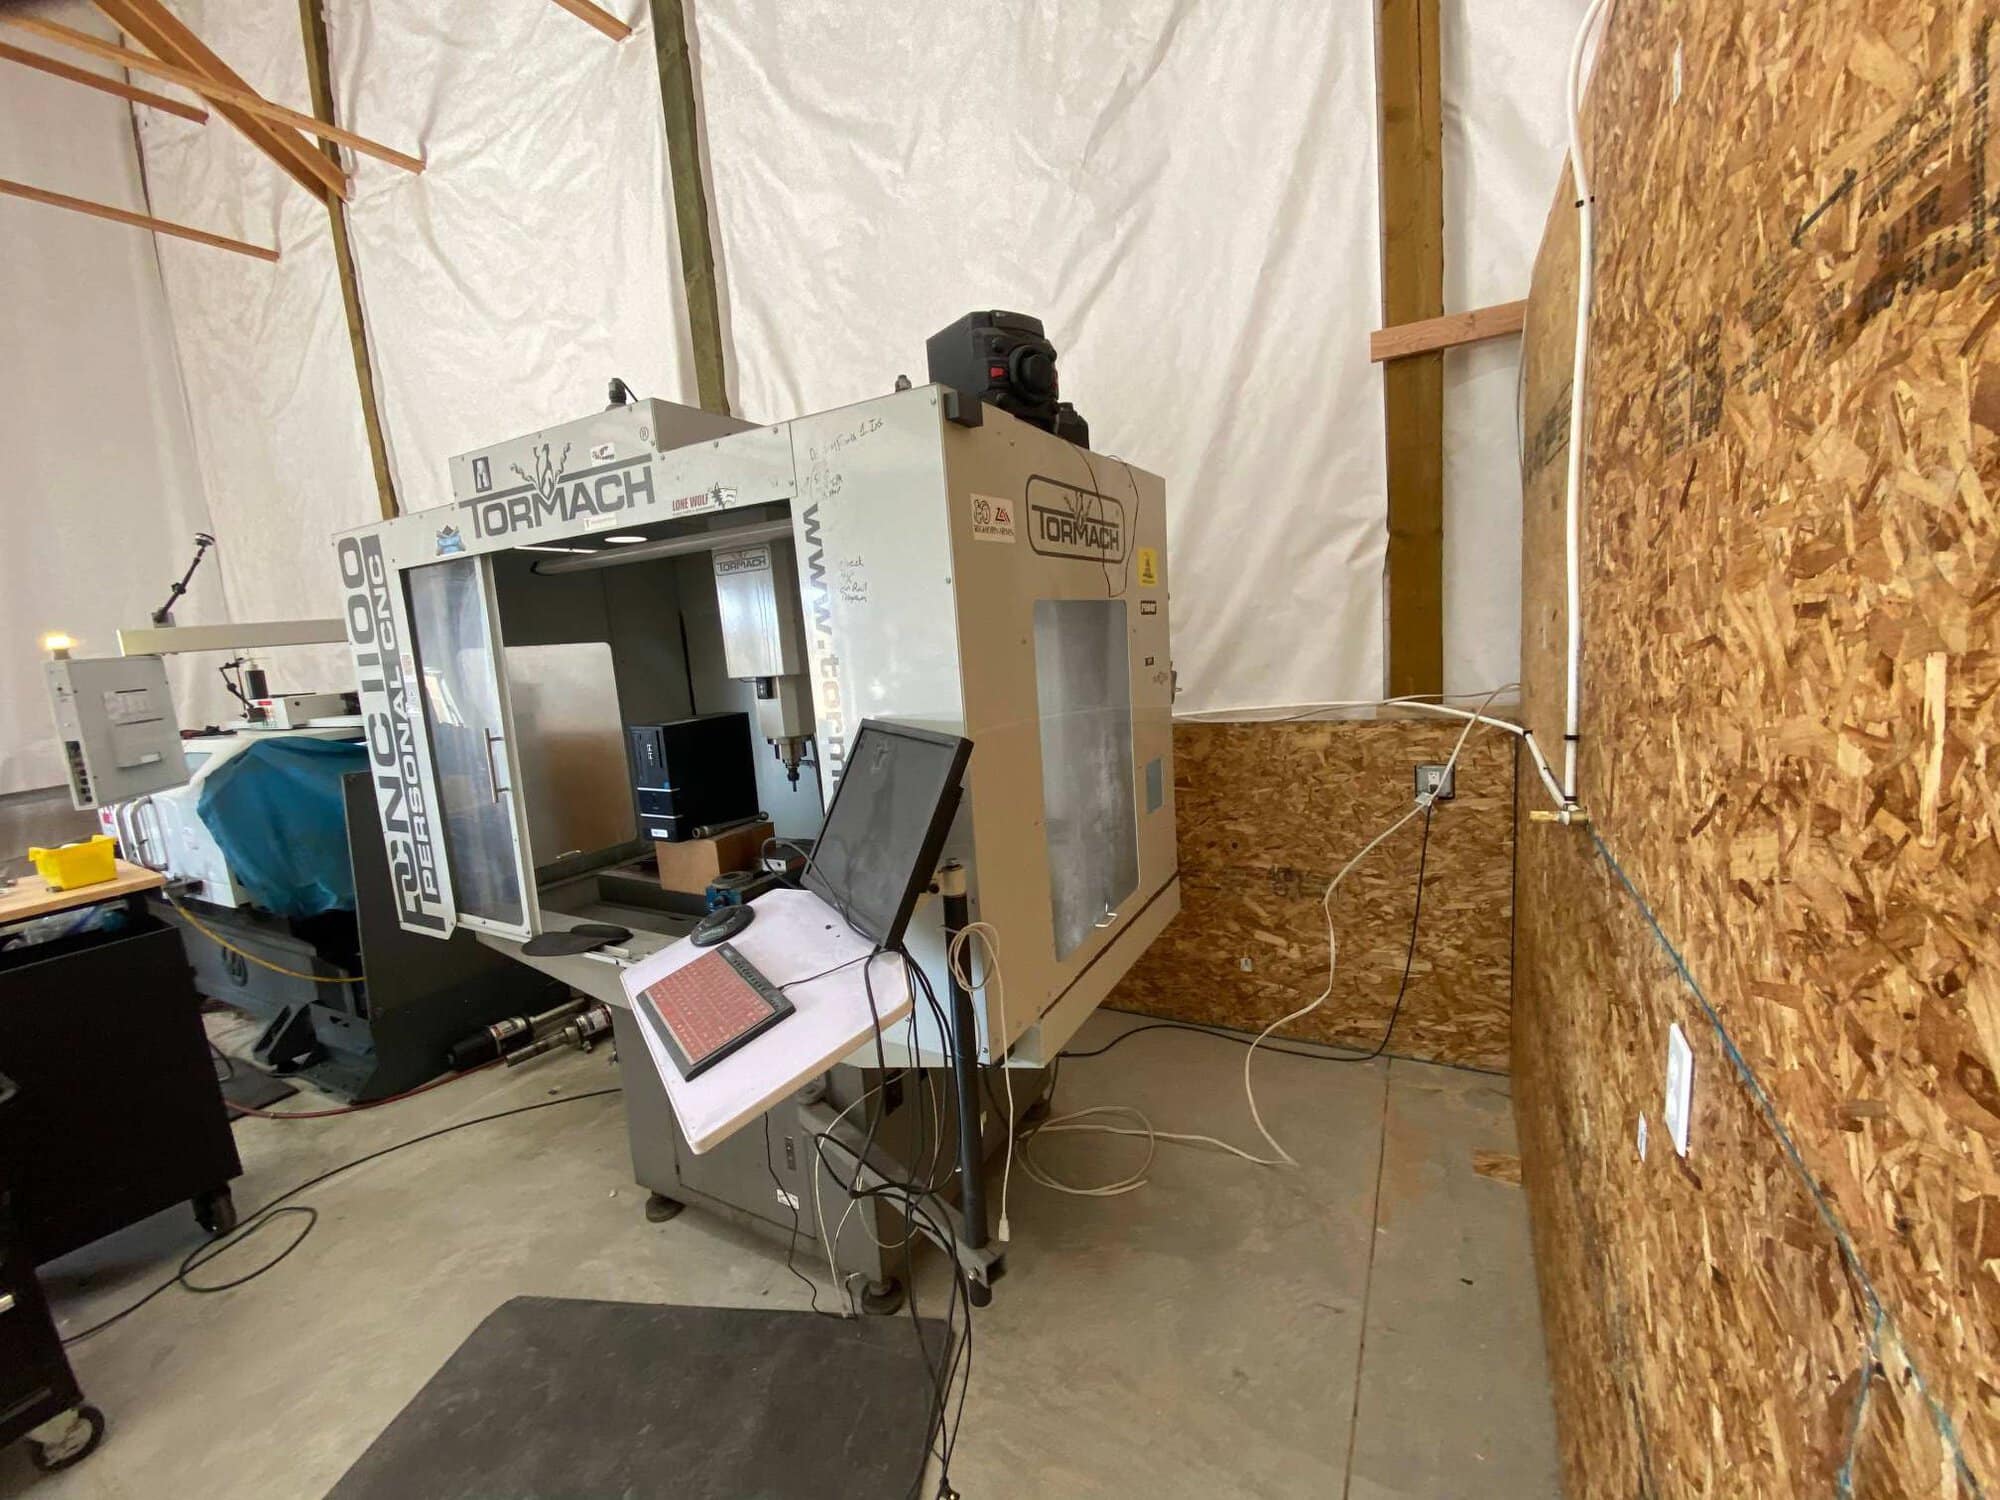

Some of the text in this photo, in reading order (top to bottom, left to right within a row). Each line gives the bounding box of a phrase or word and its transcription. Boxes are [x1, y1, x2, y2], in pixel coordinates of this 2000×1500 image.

[458, 456, 656, 539] TORMACH
[672, 497, 689, 512] LONE
[690, 493, 709, 508] WOLF
[1032, 504, 1119, 551] TORMACH
[368, 553, 396, 651] CNC
[716, 555, 766, 572] TORMACH
[803, 503, 846, 796] www.torm
[337, 536, 446, 932] PCNC 1100
[389, 665, 439, 897] PERSONAL
